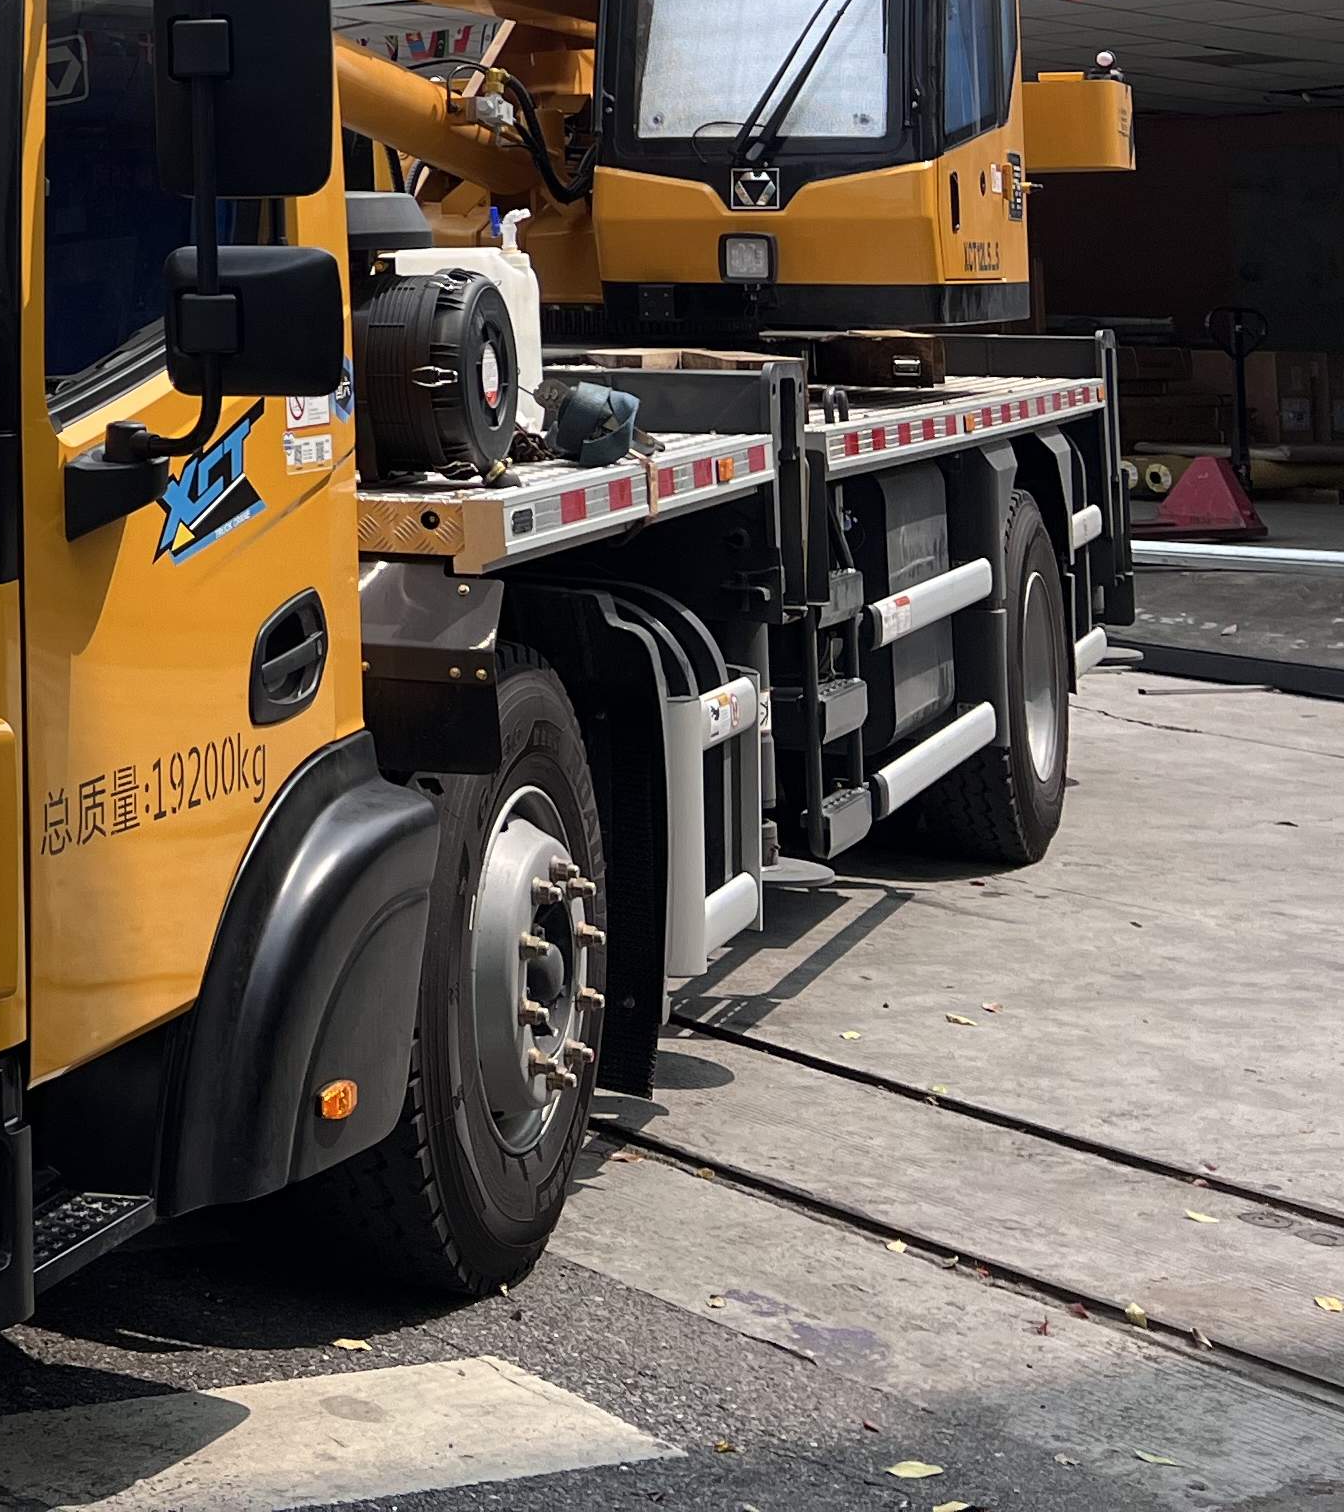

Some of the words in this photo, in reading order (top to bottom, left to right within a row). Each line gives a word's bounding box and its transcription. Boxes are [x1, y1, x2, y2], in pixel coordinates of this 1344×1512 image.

[159, 417, 251, 550] XCT
[40, 732, 267, 856] 总质量:19200kg
